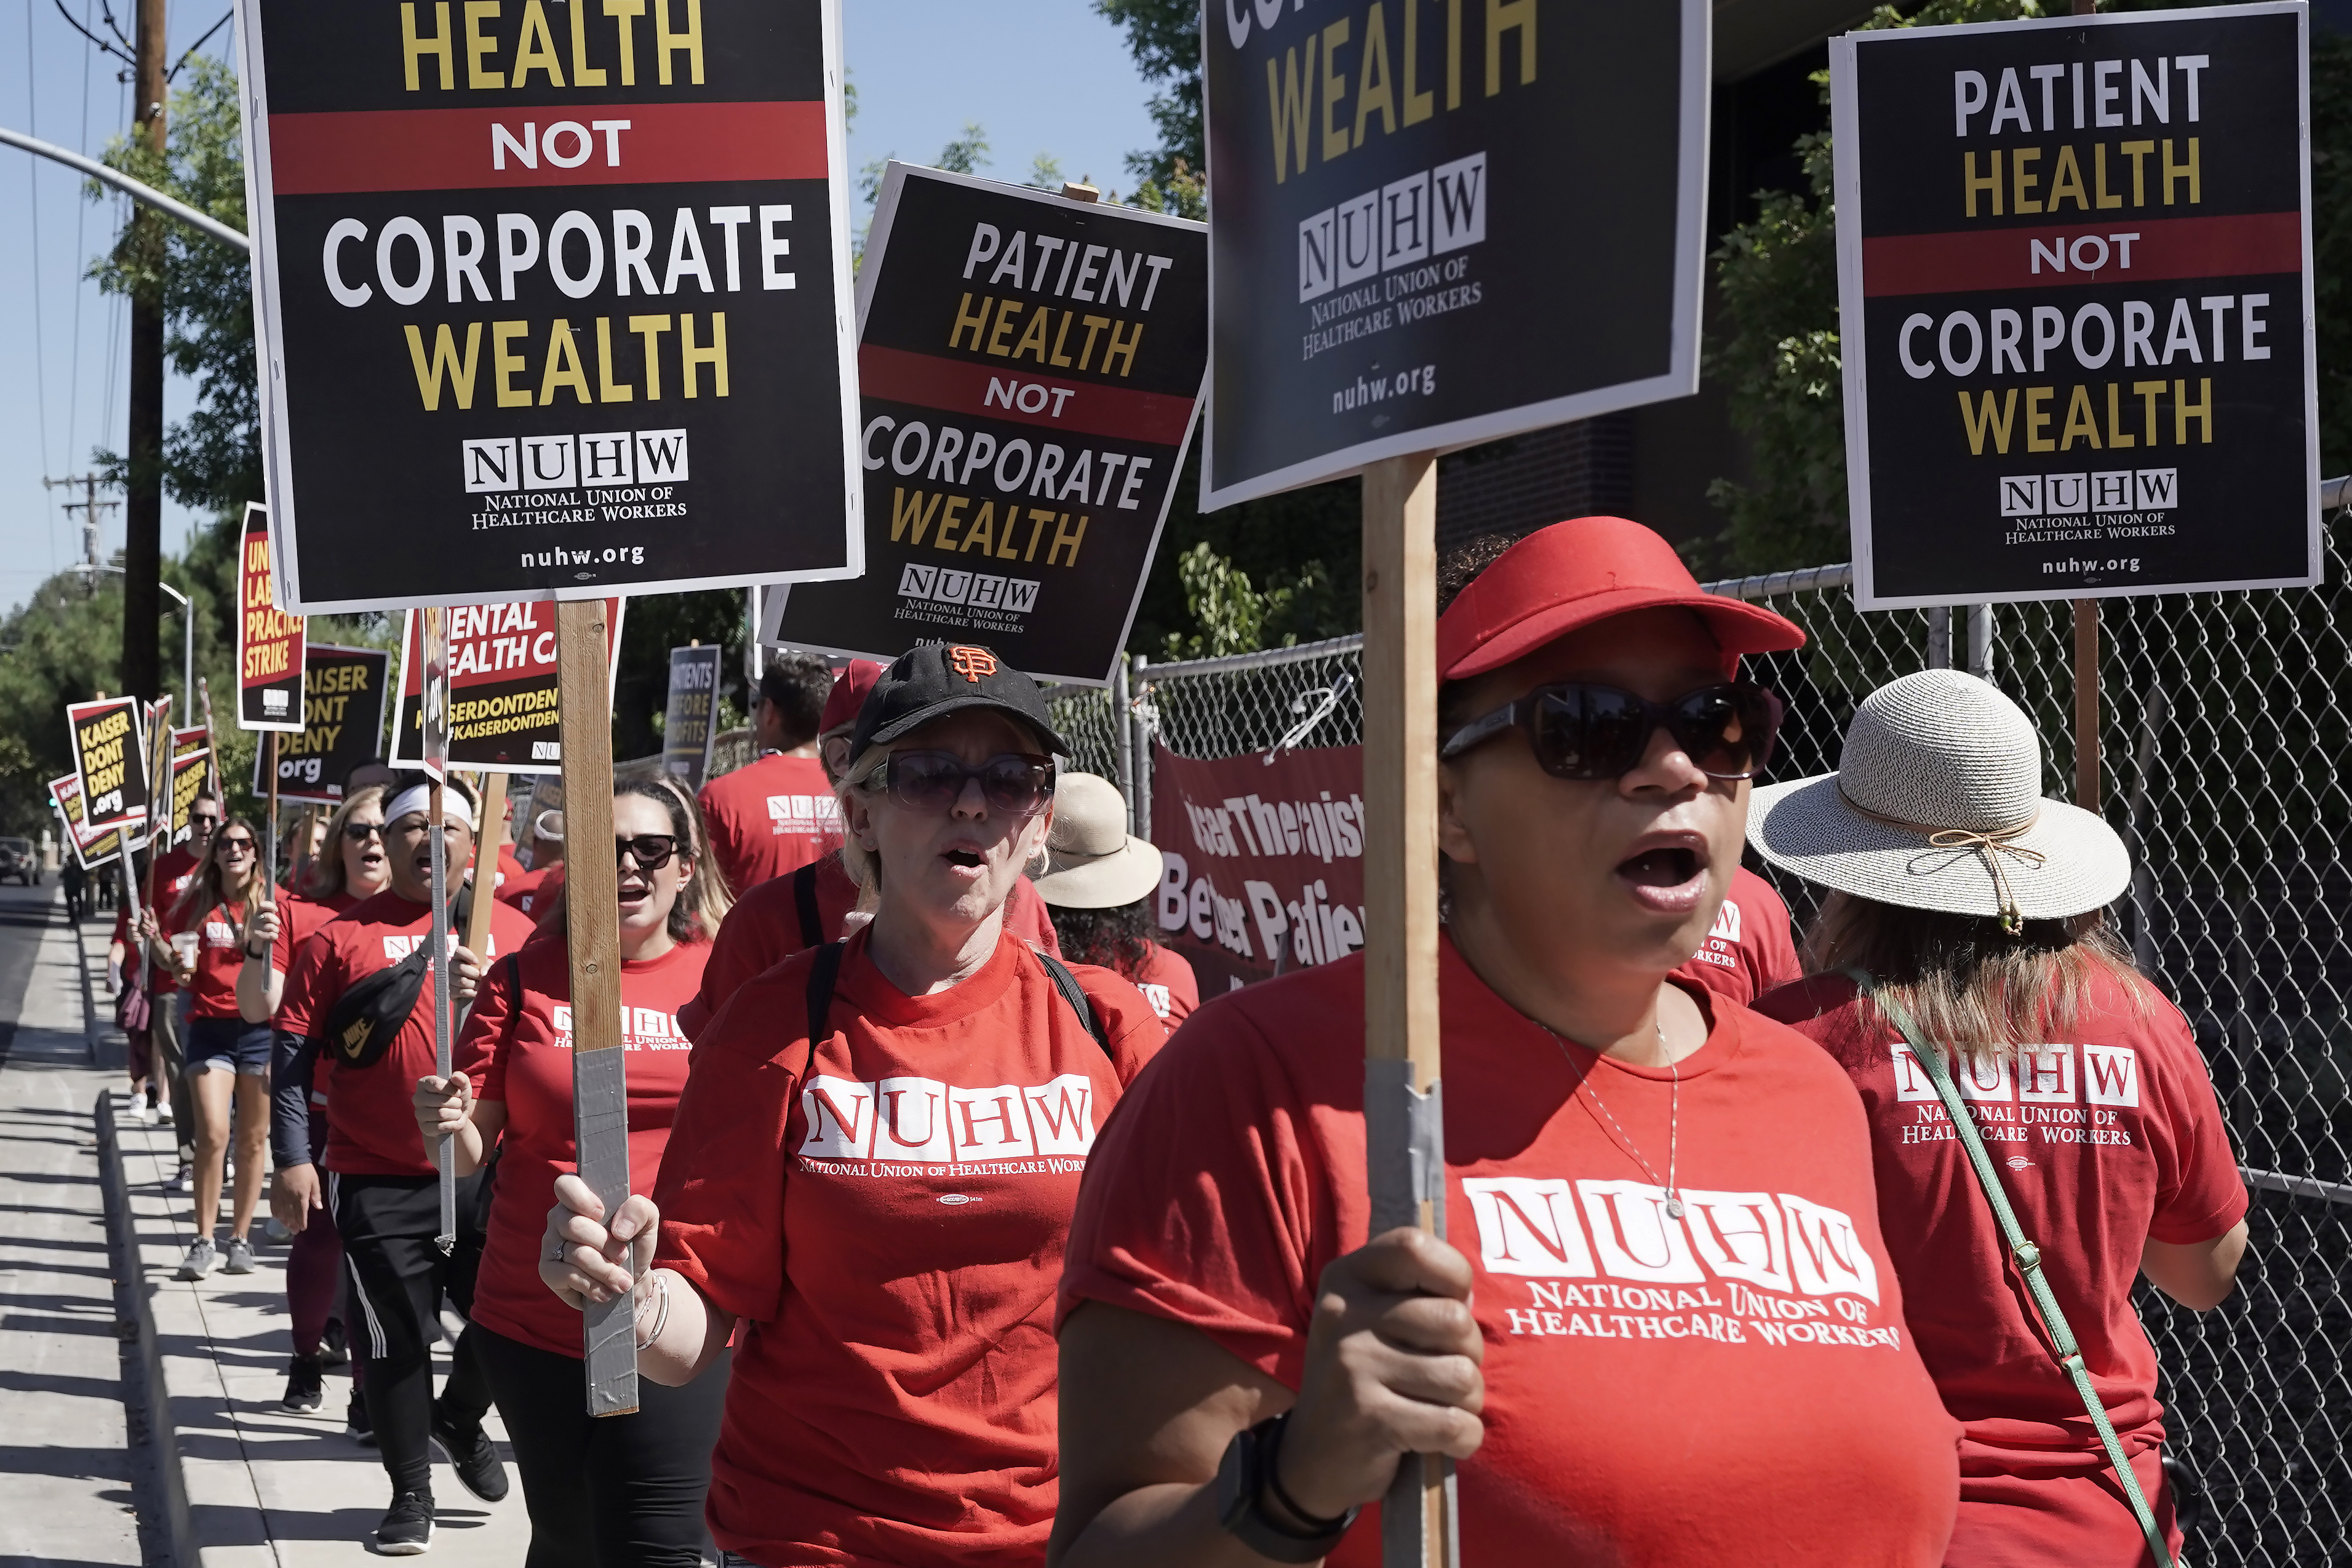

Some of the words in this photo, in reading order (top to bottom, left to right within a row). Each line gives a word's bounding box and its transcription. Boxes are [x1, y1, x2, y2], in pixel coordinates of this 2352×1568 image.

[400, 0, 705, 91] HEALTH
[1267, 0, 1537, 185] WEALTH
[1955, 54, 2210, 137] PATIENT
[492, 120, 631, 170] NOT
[1964, 137, 2201, 218] HEALTH
[1301, 157, 1484, 296] NUHW
[322, 204, 796, 308] CORPORATE
[963, 222, 1173, 312] PATIENT
[2030, 233, 2140, 274] NOT
[1311, 284, 1381, 330] NATIONAL
[1384, 264, 1440, 302] UNION
[1444, 255, 1469, 281] OF
[948, 292, 1144, 378] HEALTH
[1303, 309, 1393, 360] HEALTHCARE
[1397, 282, 1482, 326] WORKERS
[1899, 293, 2271, 380] CORPORATE
[404, 312, 729, 412] WEALTH
[984, 377, 1075, 418] NOT
[1333, 364, 1436, 414] nuhw.org
[1958, 377, 2214, 456] WEALTH
[466, 432, 686, 488] NUHW
[861, 415, 1153, 511] CORPORATE
[484, 493, 581, 512] NATIONAL
[586, 488, 646, 506] UNION
[651, 486, 674, 500] OF
[2003, 471, 2175, 513] NUHW
[471, 509, 596, 530] HEALTHCARE
[601, 503, 687, 522] WORKERS
[890, 487, 1090, 568] WEALTH
[2004, 529, 2102, 545] HEALTHCARE
[2107, 525, 2176, 539] WORKERS
[2016, 516, 2091, 531] NATIONAL
[2095, 513, 2143, 527] UNION
[2147, 512, 2165, 523] OF
[521, 546, 644, 567] nuhw.org
[2043, 557, 2140, 573] nuhw.org
[899, 565, 1039, 610] NUHW
[450, 601, 538, 640] ENTAL
[894, 608, 970, 627] HEALTHCARE
[973, 619, 1024, 634] WORKERS
[905, 599, 963, 615] NATIONAL
[967, 608, 1004, 621] UNION
[1005, 613, 1021, 622] OF
[245, 639, 290, 679] STRIKE
[449, 635, 528, 677] EALTH
[533, 631, 557, 664] C
[305, 665, 369, 695] AISER
[305, 695, 349, 723] ONT
[415, 687, 559, 730] KSERDONTDEN
[79, 710, 130, 751] KAISER
[279, 725, 341, 756] DENY
[84, 737, 124, 774] DONT
[87, 760, 125, 798] DENY
[93, 789, 123, 816] .org
[1243, 878, 1365, 966] Patie
[1710, 939, 1727, 952] OF
[342, 1017, 367, 1048] NIKE
[635, 1035, 677, 1045] UNION
[1895, 1047, 2135, 1102] NUHW
[803, 1080, 1092, 1155] NUHW
[1902, 1124, 2028, 1144] HEALCARE
[2041, 1126, 2131, 1145] WORKERS
[1916, 1105, 2015, 1123] NAONAL
[2019, 1105, 2087, 1123] UNION
[2094, 1110, 2118, 1126] OF
[799, 1158, 869, 1177] NATIONAL
[870, 1163, 923, 1178] UNION
[928, 1165, 947, 1176] OF
[948, 1161, 1046, 1176] HEALTHCARE
[1469, 1184, 1870, 1295] NUHW
[1526, 1280, 1722, 1312] NATIONAL
[1726, 1283, 1828, 1321] UNION
[1835, 1296, 1868, 1326] OF
[1505, 1307, 1747, 1345] HEALTHCARE
[1748, 1319, 1901, 1352] WORKERS
